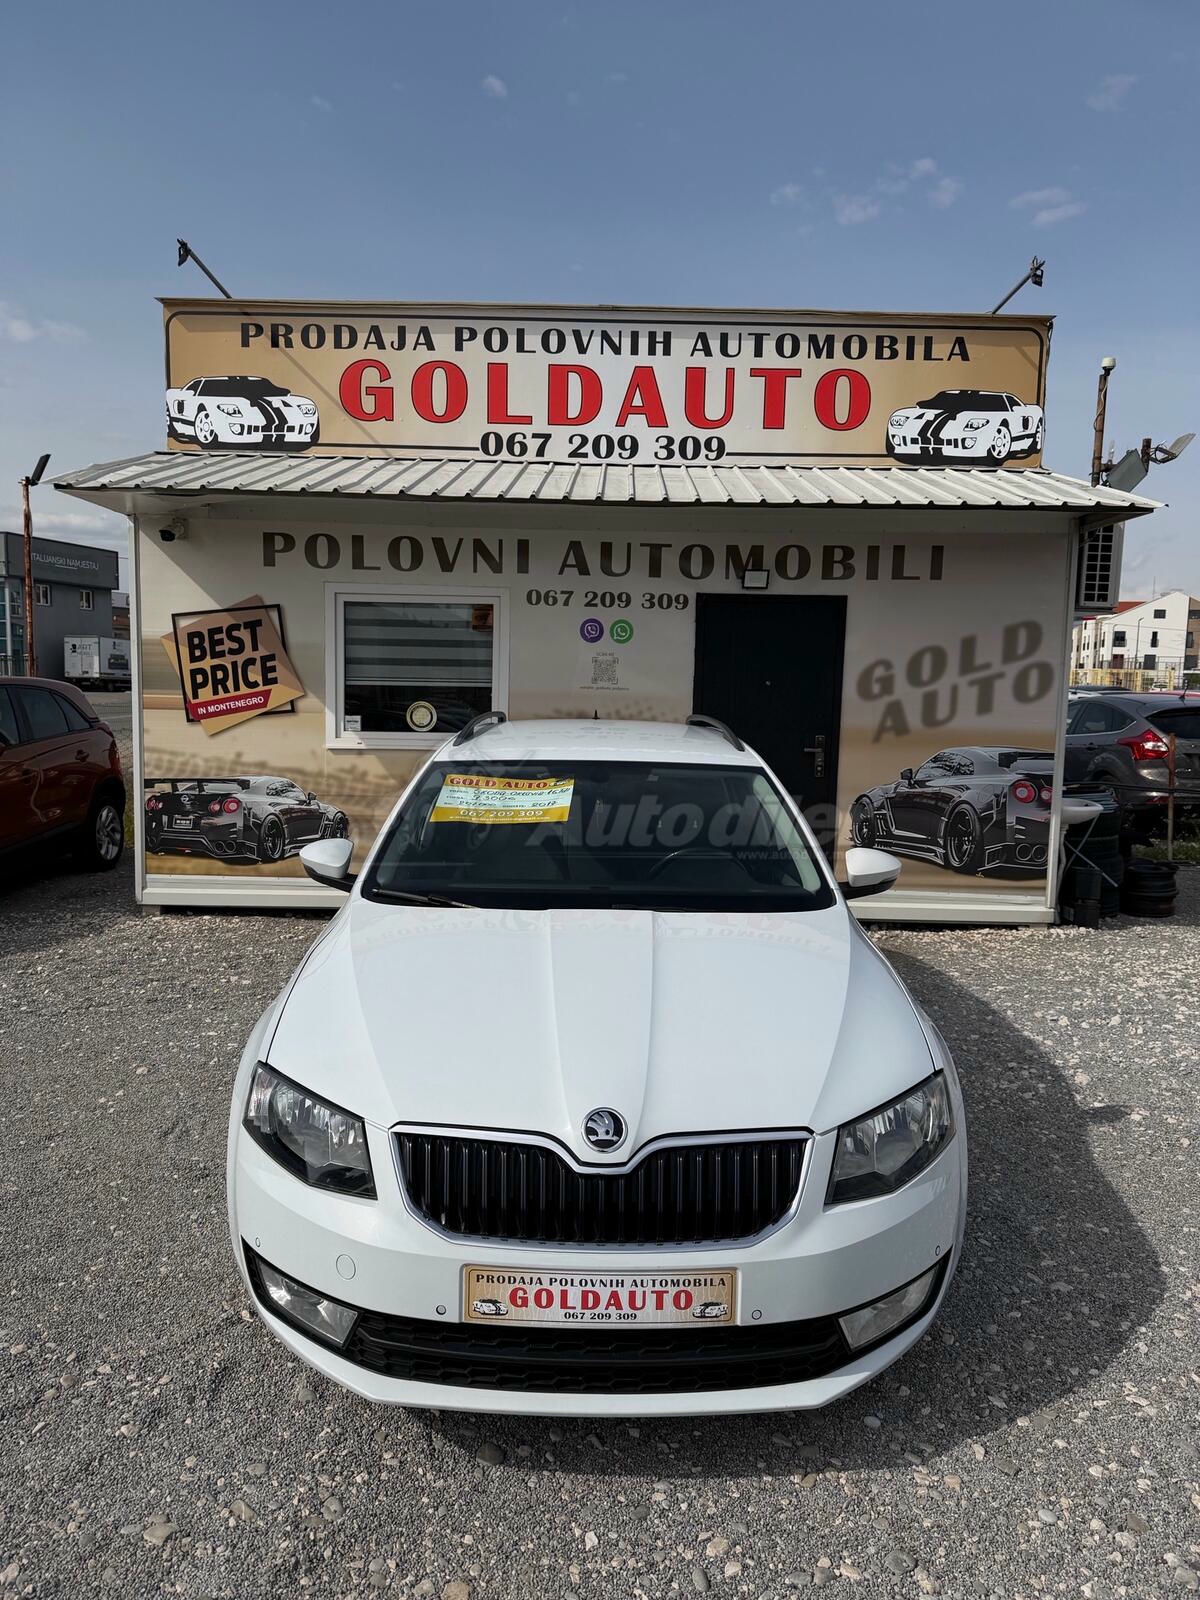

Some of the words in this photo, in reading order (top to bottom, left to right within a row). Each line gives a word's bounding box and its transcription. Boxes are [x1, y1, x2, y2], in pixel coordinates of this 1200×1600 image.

[240, 322, 436, 351] PRODAJA
[454, 326, 672, 356] POLOVNIH
[690, 331, 970, 361] AUTOMOBILA
[339, 358, 871, 431] GOLDAUTO
[480, 431, 552, 457] 067
[568, 433, 639, 459] 209
[653, 435, 726, 461] 309
[263, 532, 529, 574] POLOVNI
[558, 540, 944, 581] AUTOMOBILI
[526, 589, 574, 606] 067
[584, 590, 632, 608] 209
[641, 592, 689, 610] 309
[187, 619, 262, 664] BEST
[190, 653, 278, 700] PRICE
[857, 620, 1043, 702] GOLD
[208, 696, 264, 713] MONTENEGRO
[872, 661, 1054, 744] AUTO
[449, 777, 497, 787] GOLD
[503, 781, 548, 789] AUTO
[476, 1274, 543, 1286] PRODAJA
[550, 1277, 624, 1288] POLOVNIH
[630, 1277, 726, 1288] AUTOMOBILA
[509, 1286, 694, 1311] GOLDAUTO
[564, 1311, 585, 1320] 067
[589, 1312, 612, 1321] 209
[615, 1312, 637, 1321] 309
